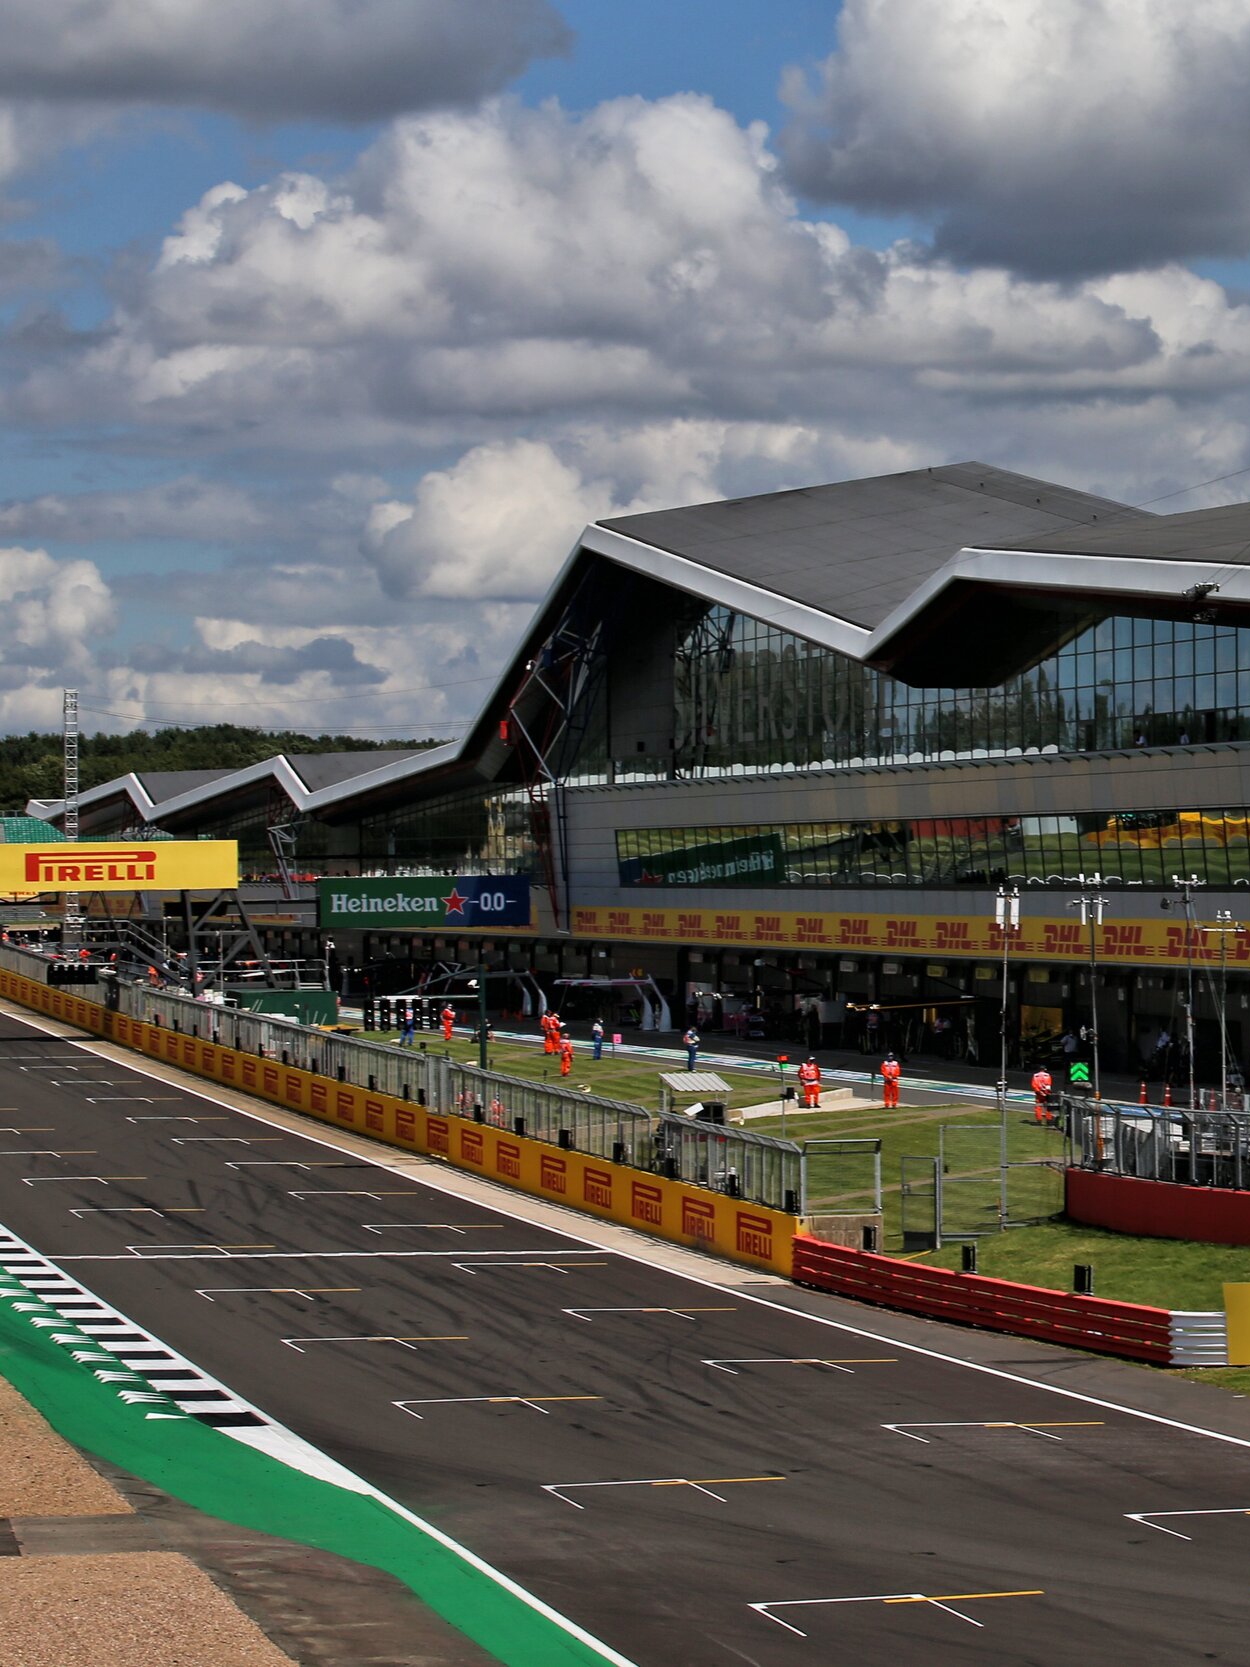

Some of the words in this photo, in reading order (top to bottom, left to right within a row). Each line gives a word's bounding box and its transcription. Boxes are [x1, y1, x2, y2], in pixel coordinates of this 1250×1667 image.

[25, 851, 157, 882] PIRELLI
[330, 893, 439, 913] Heineken
[755, 916, 784, 942] DHL
[796, 918, 828, 943] DHL
[839, 919, 873, 945] DHL
[886, 920, 921, 947] DHL
[935, 922, 972, 950] DHL
[1043, 924, 1085, 955] DHL
[1103, 925, 1148, 957] DHL
[1166, 927, 1214, 959] DHL
[496, 1140, 520, 1180] PIRELLI
[541, 1154, 566, 1195] PIRELLI
[584, 1166, 612, 1210] PIRELLI
[631, 1180, 662, 1226] PIRELLI
[682, 1196, 715, 1243] PIRELLI
[736, 1211, 773, 1261] PIRELLI
